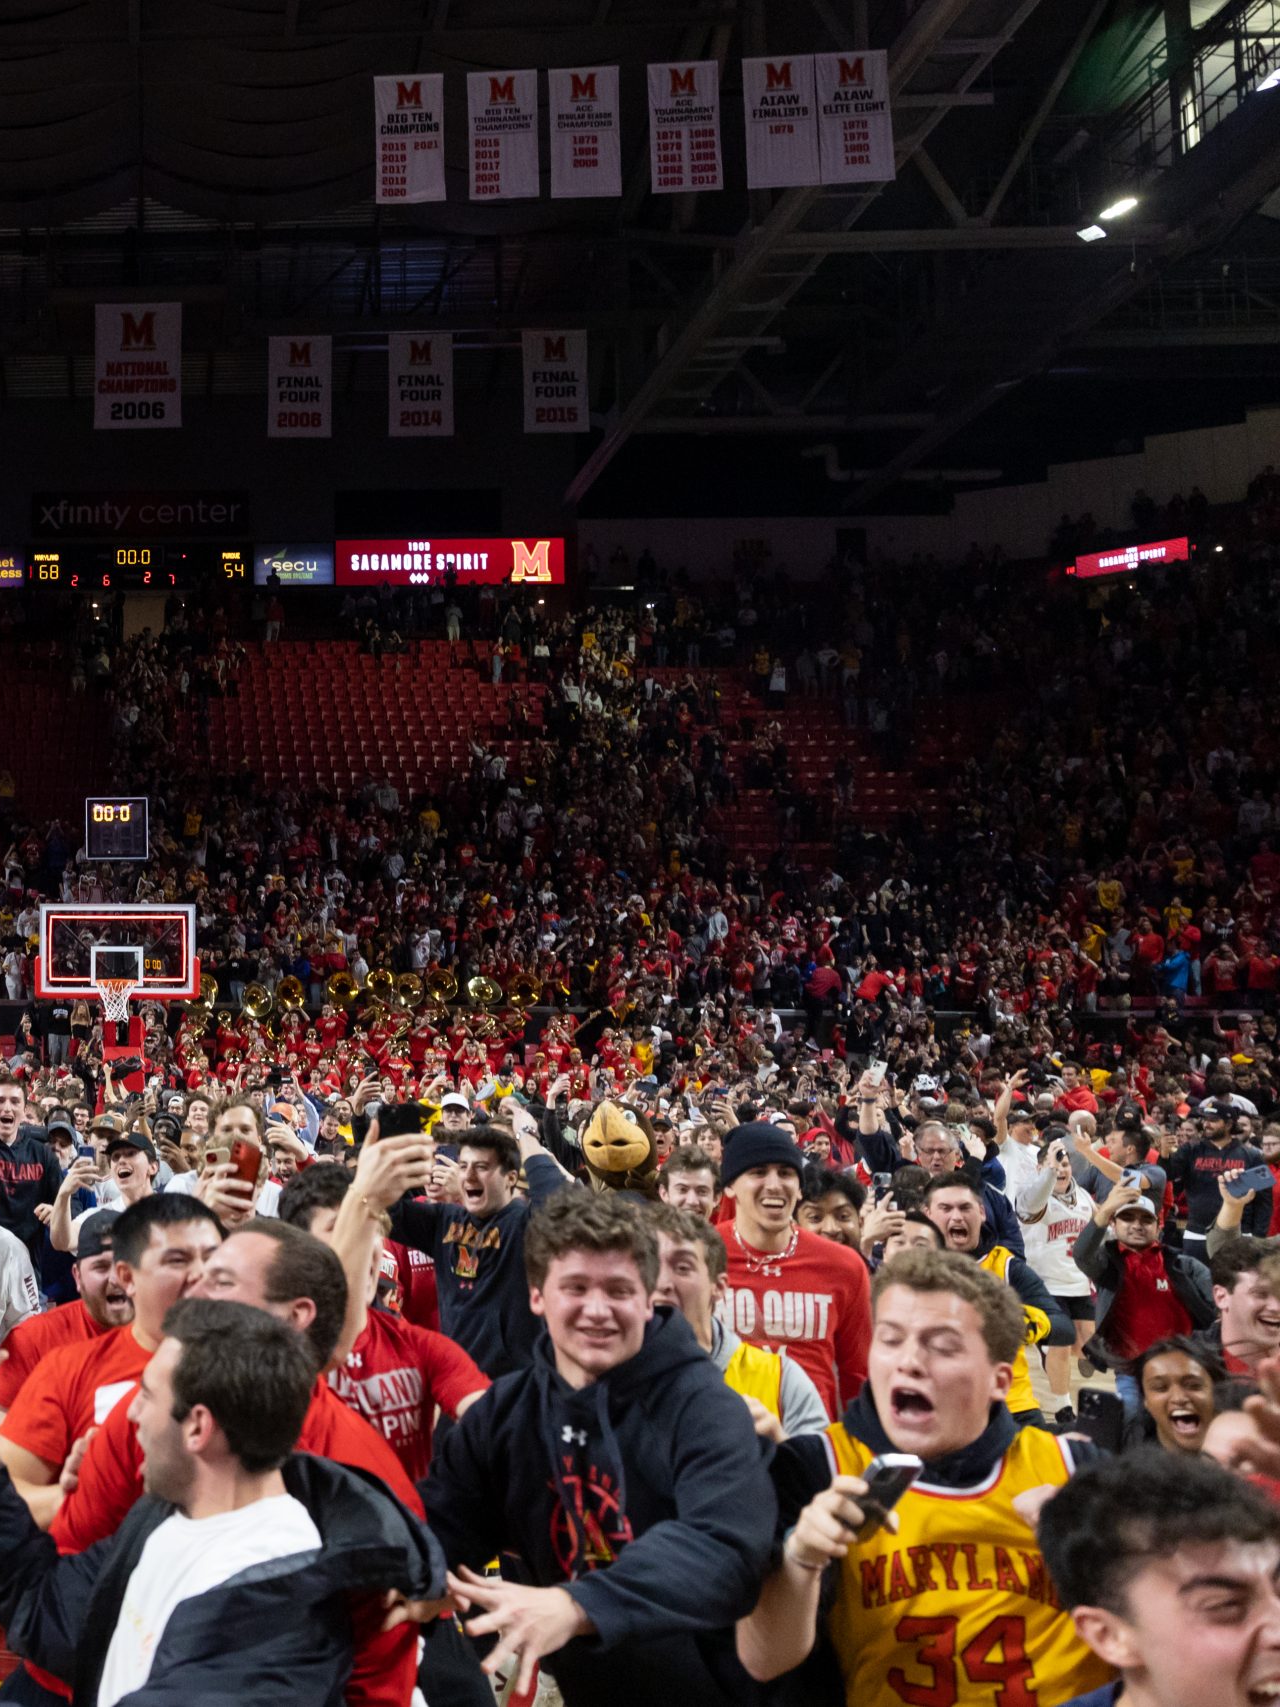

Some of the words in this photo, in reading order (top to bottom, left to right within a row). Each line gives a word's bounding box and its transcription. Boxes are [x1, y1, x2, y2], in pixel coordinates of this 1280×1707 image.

[765, 62, 792, 91] M
[838, 57, 866, 86] M
[570, 73, 598, 102] M
[669, 68, 697, 97] M
[397, 81, 422, 109] M
[488, 76, 516, 105] M
[834, 90, 873, 101] AIAW
[760, 95, 800, 106] AIAW
[655, 106, 714, 116] TOURNAMENT
[753, 107, 808, 118] FINALISTS
[824, 104, 850, 114] ELITE
[855, 102, 885, 112] EIGHT
[388, 114, 407, 123] BIG
[412, 113, 432, 122] TEN
[474, 115, 532, 123] TOURNAMENT
[558, 120, 612, 128] CHAMPIONS
[657, 115, 712, 123] CHAMPIONS
[381, 123, 439, 134] CHAMPIONS
[476, 123, 530, 131] CHAMPIONS
[382, 166, 406, 174] 2017
[475, 162, 499, 170] 2017
[120, 312, 156, 352] M
[289, 342, 311, 367] M
[410, 341, 432, 365] M
[544, 336, 568, 362] M
[107, 361, 169, 376] NATIONAL
[278, 377, 322, 388] FINAL
[398, 375, 444, 386] FINAL
[533, 371, 579, 382] FINAL
[98, 379, 176, 393] CHAMPIONS
[535, 386, 576, 397] FOUR
[279, 392, 319, 402] FOUR
[401, 390, 441, 401] FOUR
[111, 402, 165, 420] 2006
[536, 407, 577, 422] 2015
[278, 412, 321, 427] 2006
[400, 410, 442, 427] 2014
[40, 500, 131, 530] xfinity
[139, 500, 241, 523] center
[117, 550, 150, 564] 00.0
[351, 554, 431, 570] SAGAMORE
[436, 553, 488, 570] SPIRIT
[511, 541, 552, 581] M
[39, 565, 59, 579] 68
[224, 563, 244, 578] 54
[272, 561, 317, 571] secu
[71, 575, 78, 586] 2
[103, 575, 110, 586] 6
[144, 572, 151, 583] 2
[168, 574, 175, 584] 7
[1194, 1158, 1246, 1171] MARYLAND
[1156, 1279, 1169, 1290] M
[720, 1287, 755, 1334] NO
[763, 1290, 832, 1339] QUIT
[859, 1543, 1061, 1611] MARYLAN
[888, 1615, 1039, 1707] 34
